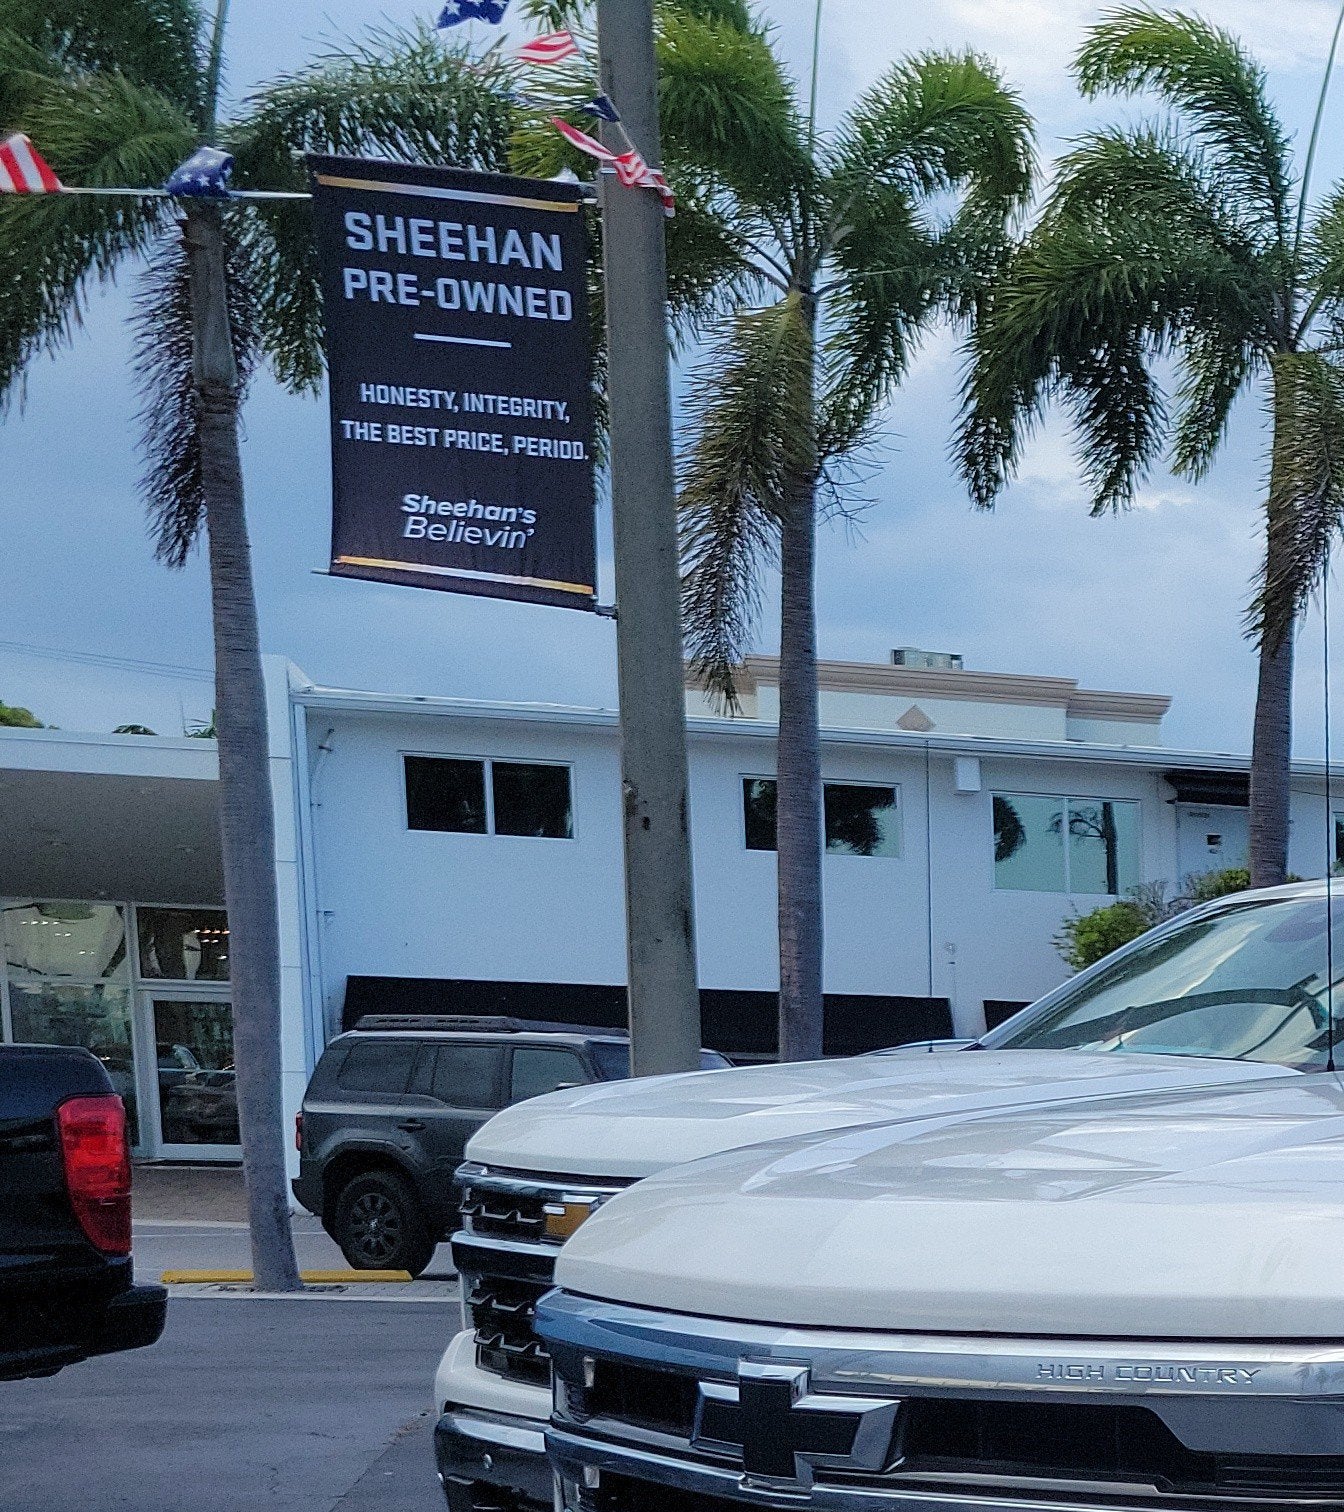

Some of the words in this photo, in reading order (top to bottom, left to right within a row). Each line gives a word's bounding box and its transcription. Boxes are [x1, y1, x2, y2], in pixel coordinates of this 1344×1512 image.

[344, 211, 563, 271] SHEEHAN
[342, 267, 573, 321] PRE-OWNED
[359, 382, 459, 414] HONESTY,
[463, 392, 571, 424] INTEGRITY,
[340, 419, 383, 442] THE
[387, 424, 440, 447] BEST
[443, 429, 509, 456] PRICE,
[512, 435, 590, 461] PERIOD.
[400, 493, 537, 525] Sheehan's
[403, 515, 535, 549] Believin'
[1035, 1363, 1104, 1381] HIGH
[1114, 1365, 1261, 1385] COUNTRY
